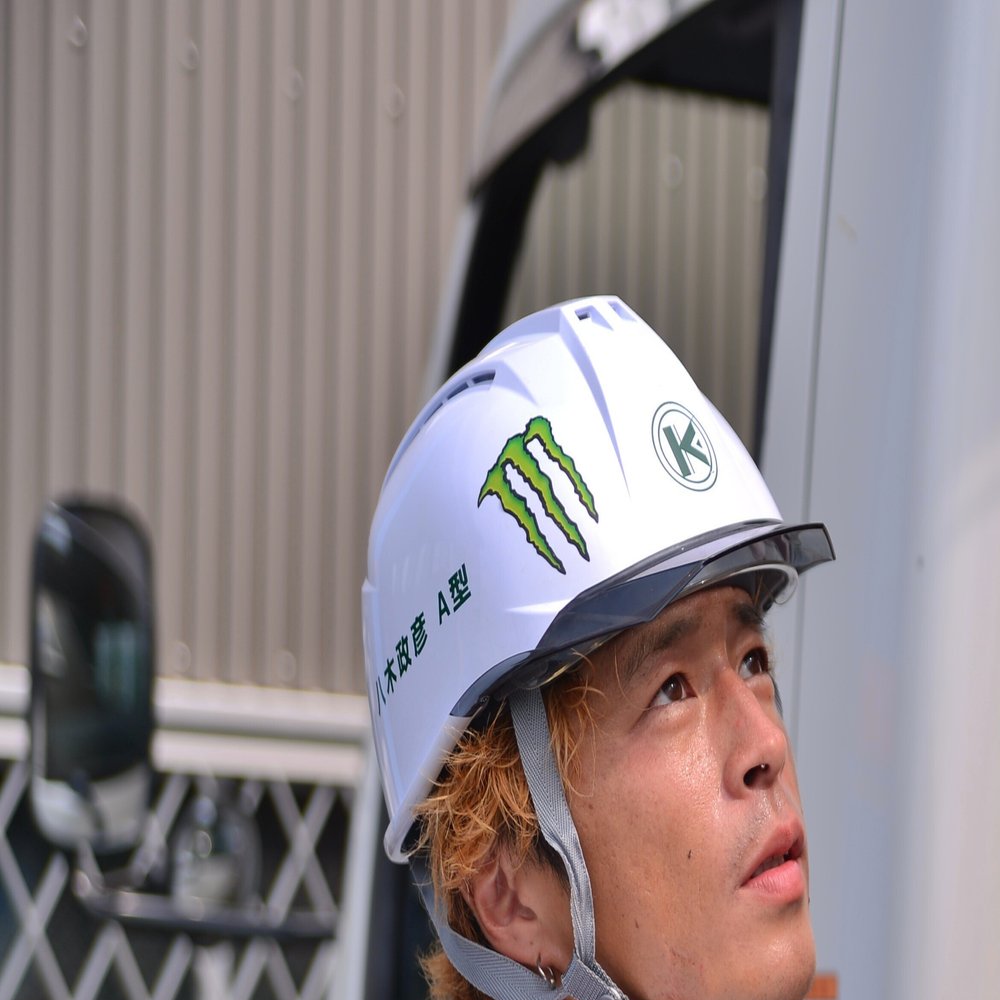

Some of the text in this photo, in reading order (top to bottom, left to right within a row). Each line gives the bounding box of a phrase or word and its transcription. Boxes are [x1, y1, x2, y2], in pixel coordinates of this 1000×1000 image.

[376, 563, 472, 716] 八木政彦 A型
